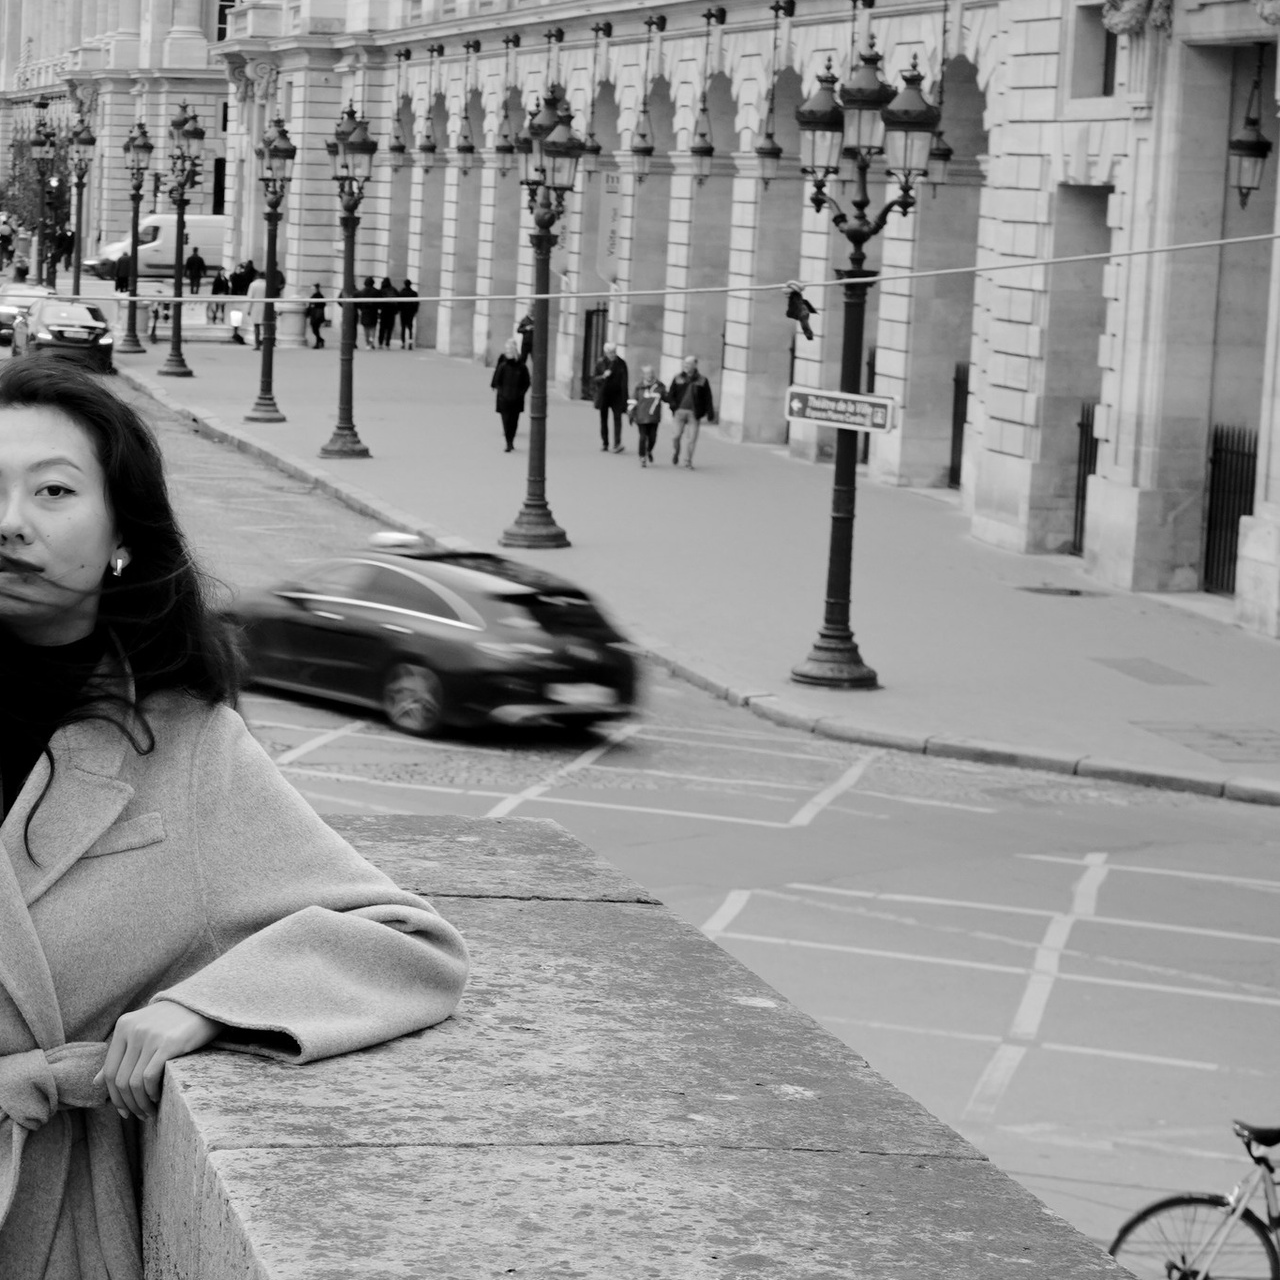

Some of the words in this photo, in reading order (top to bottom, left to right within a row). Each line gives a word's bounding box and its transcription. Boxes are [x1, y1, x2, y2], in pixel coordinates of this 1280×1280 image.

[836, 399, 847, 412] de
[847, 401, 856, 413] la
[855, 401, 873, 415] Ville
